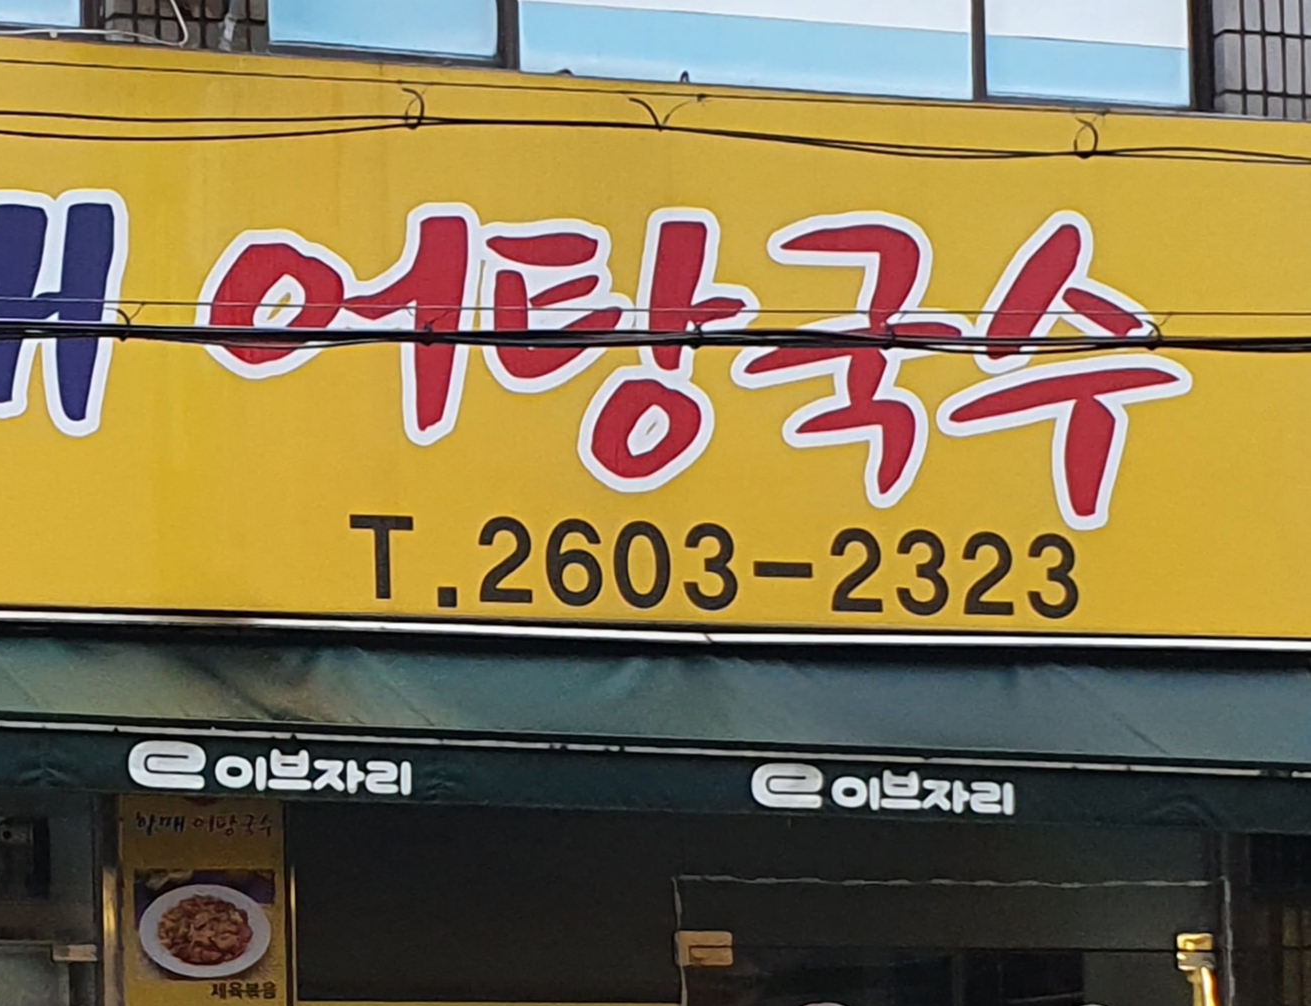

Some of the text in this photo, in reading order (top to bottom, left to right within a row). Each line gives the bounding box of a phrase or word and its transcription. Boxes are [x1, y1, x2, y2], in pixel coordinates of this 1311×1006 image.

[198, 204, 1192, 529] 어탕국수
[214, 747, 412, 795] 이브자리
[831, 770, 1014, 815] 이브자리
